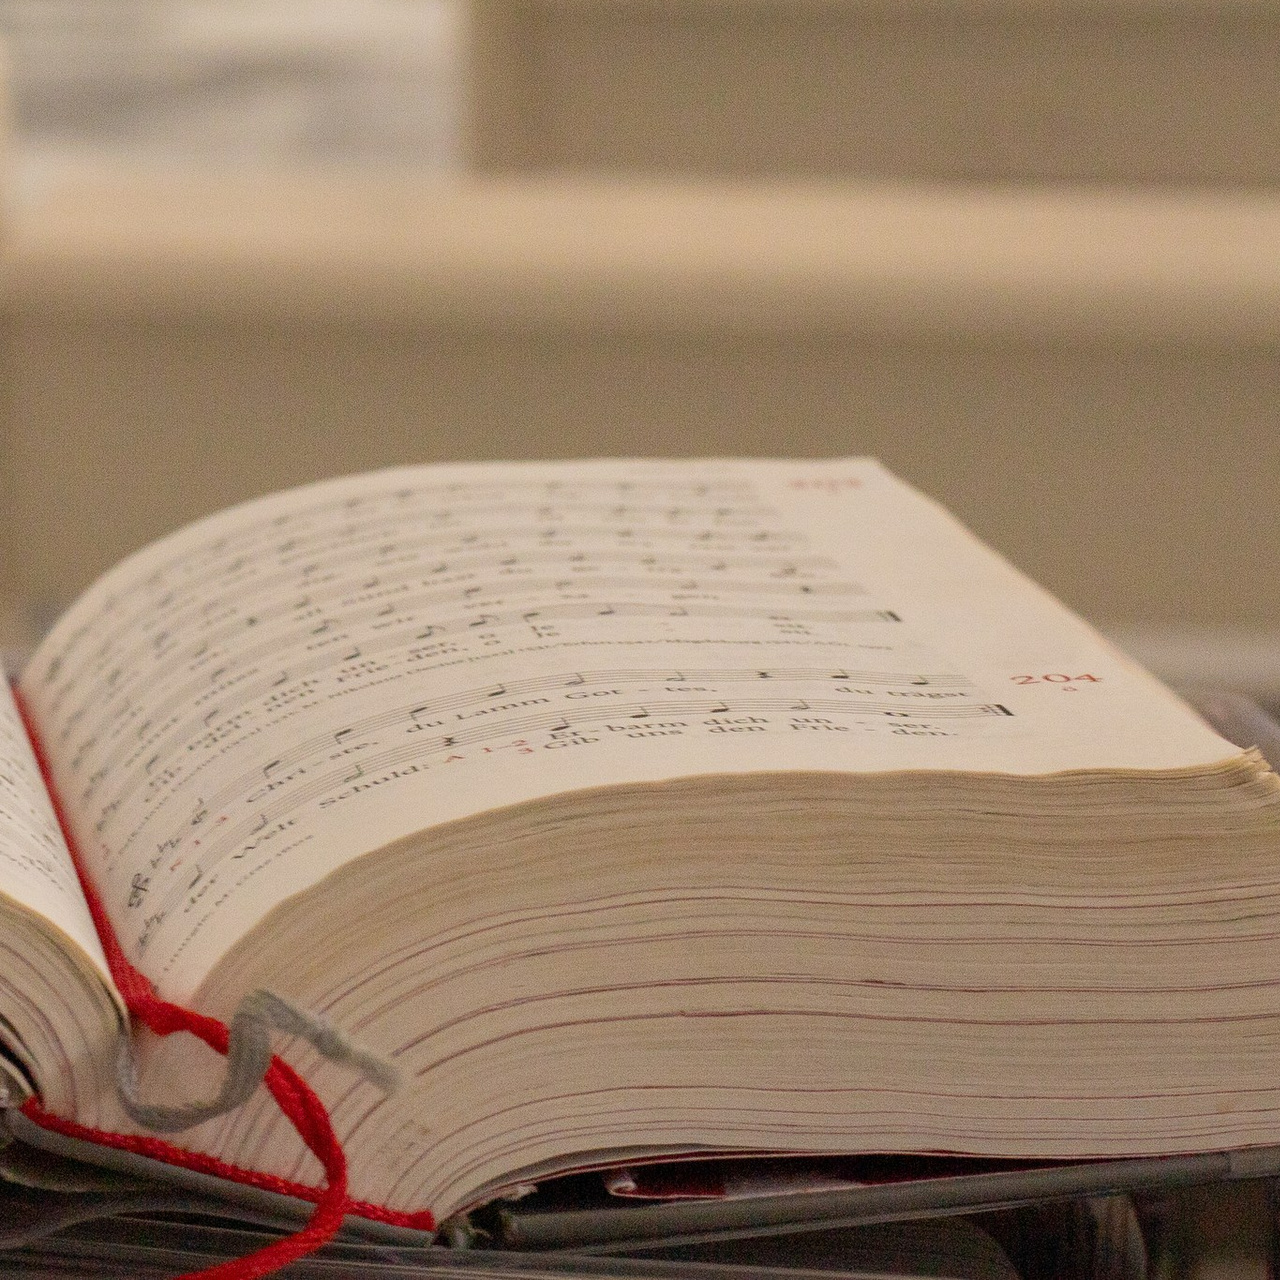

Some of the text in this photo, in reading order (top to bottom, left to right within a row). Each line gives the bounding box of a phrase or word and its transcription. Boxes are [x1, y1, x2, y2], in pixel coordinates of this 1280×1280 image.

[1009, 672, 1103, 685] 204
[406, 721, 444, 734] du
[456, 697, 551, 720] Lamm
[835, 686, 873, 695] du
